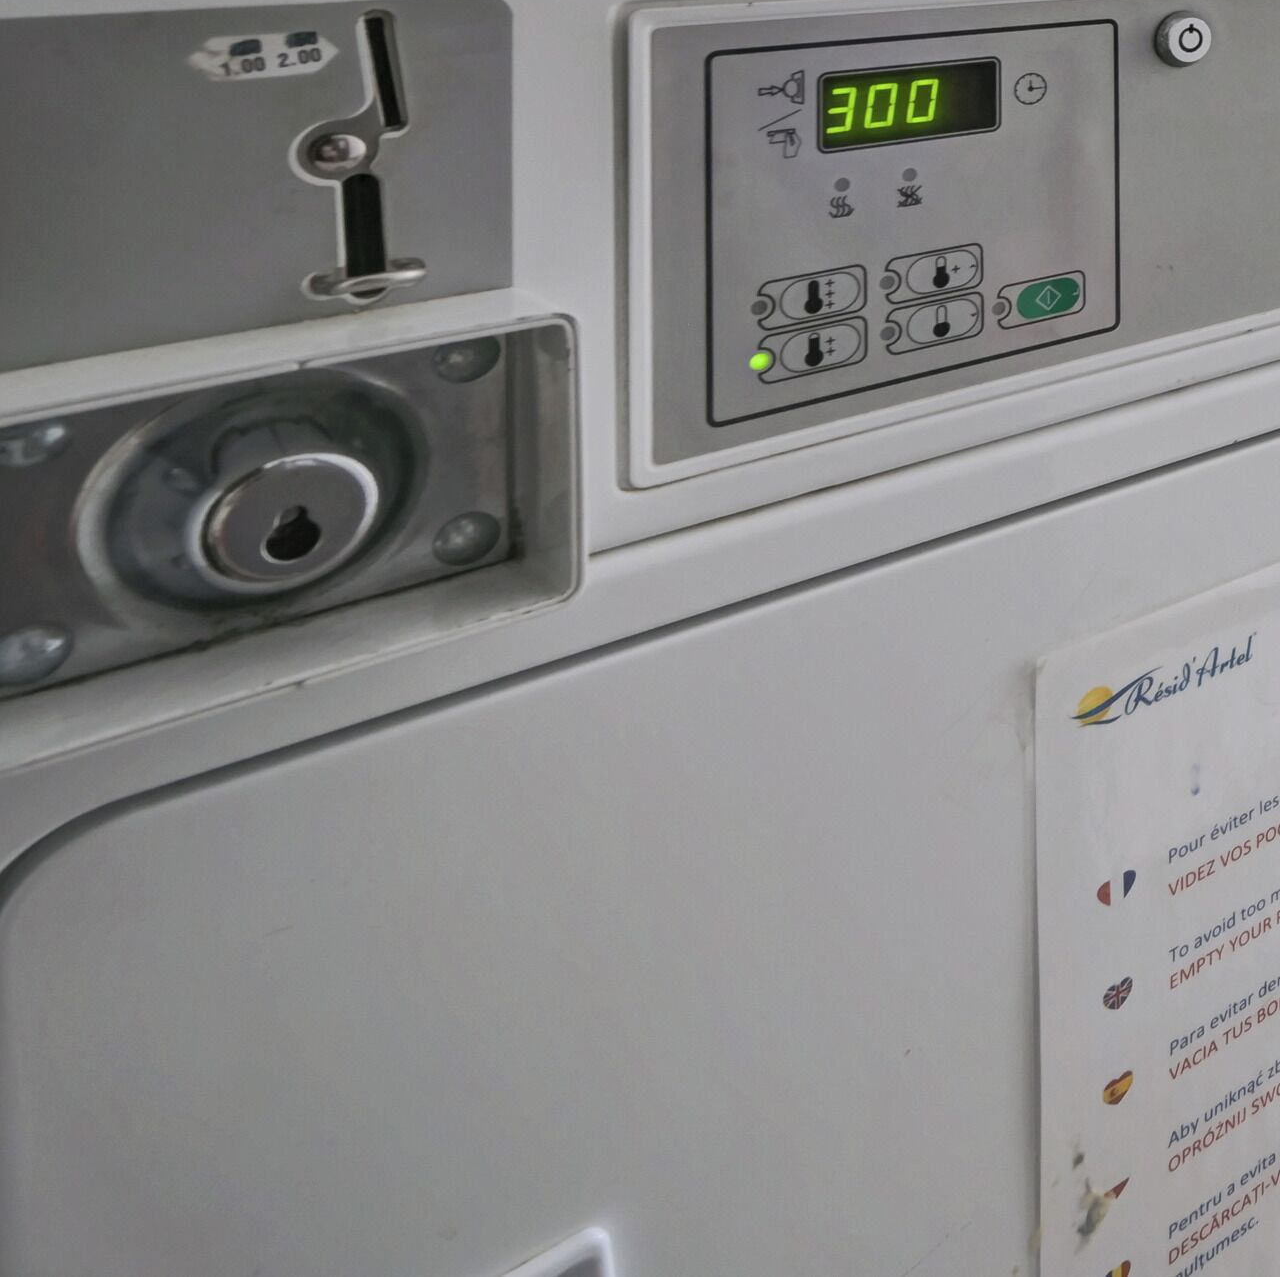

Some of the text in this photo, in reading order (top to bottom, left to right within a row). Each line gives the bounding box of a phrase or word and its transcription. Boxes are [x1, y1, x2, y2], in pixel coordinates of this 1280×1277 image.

[278, 48, 321, 68] 2.00
[826, 77, 940, 135] 300
[1168, 834, 1205, 863] Pour
[1211, 807, 1254, 841] éviter
[1260, 796, 1279, 814] les
[1168, 859, 1216, 896] VIDEZ
[1220, 839, 1251, 867] VOS
[1169, 944, 1189, 963] To
[1194, 912, 1236, 949] avoid
[1241, 899, 1266, 921] too
[1169, 946, 1224, 990] EMPTY
[1229, 917, 1271, 952] YOUR
[1169, 1025, 1204, 1056] Para
[1210, 993, 1254, 1029] evitar
[1169, 1040, 1218, 1080] VACIA
[1223, 1016, 1252, 1045] TUS
[1168, 1118, 1199, 1148] Aby
[1169, 1192, 1222, 1239] Pentru
[1227, 1183, 1235, 1196] a
[1240, 1152, 1276, 1187] evita
